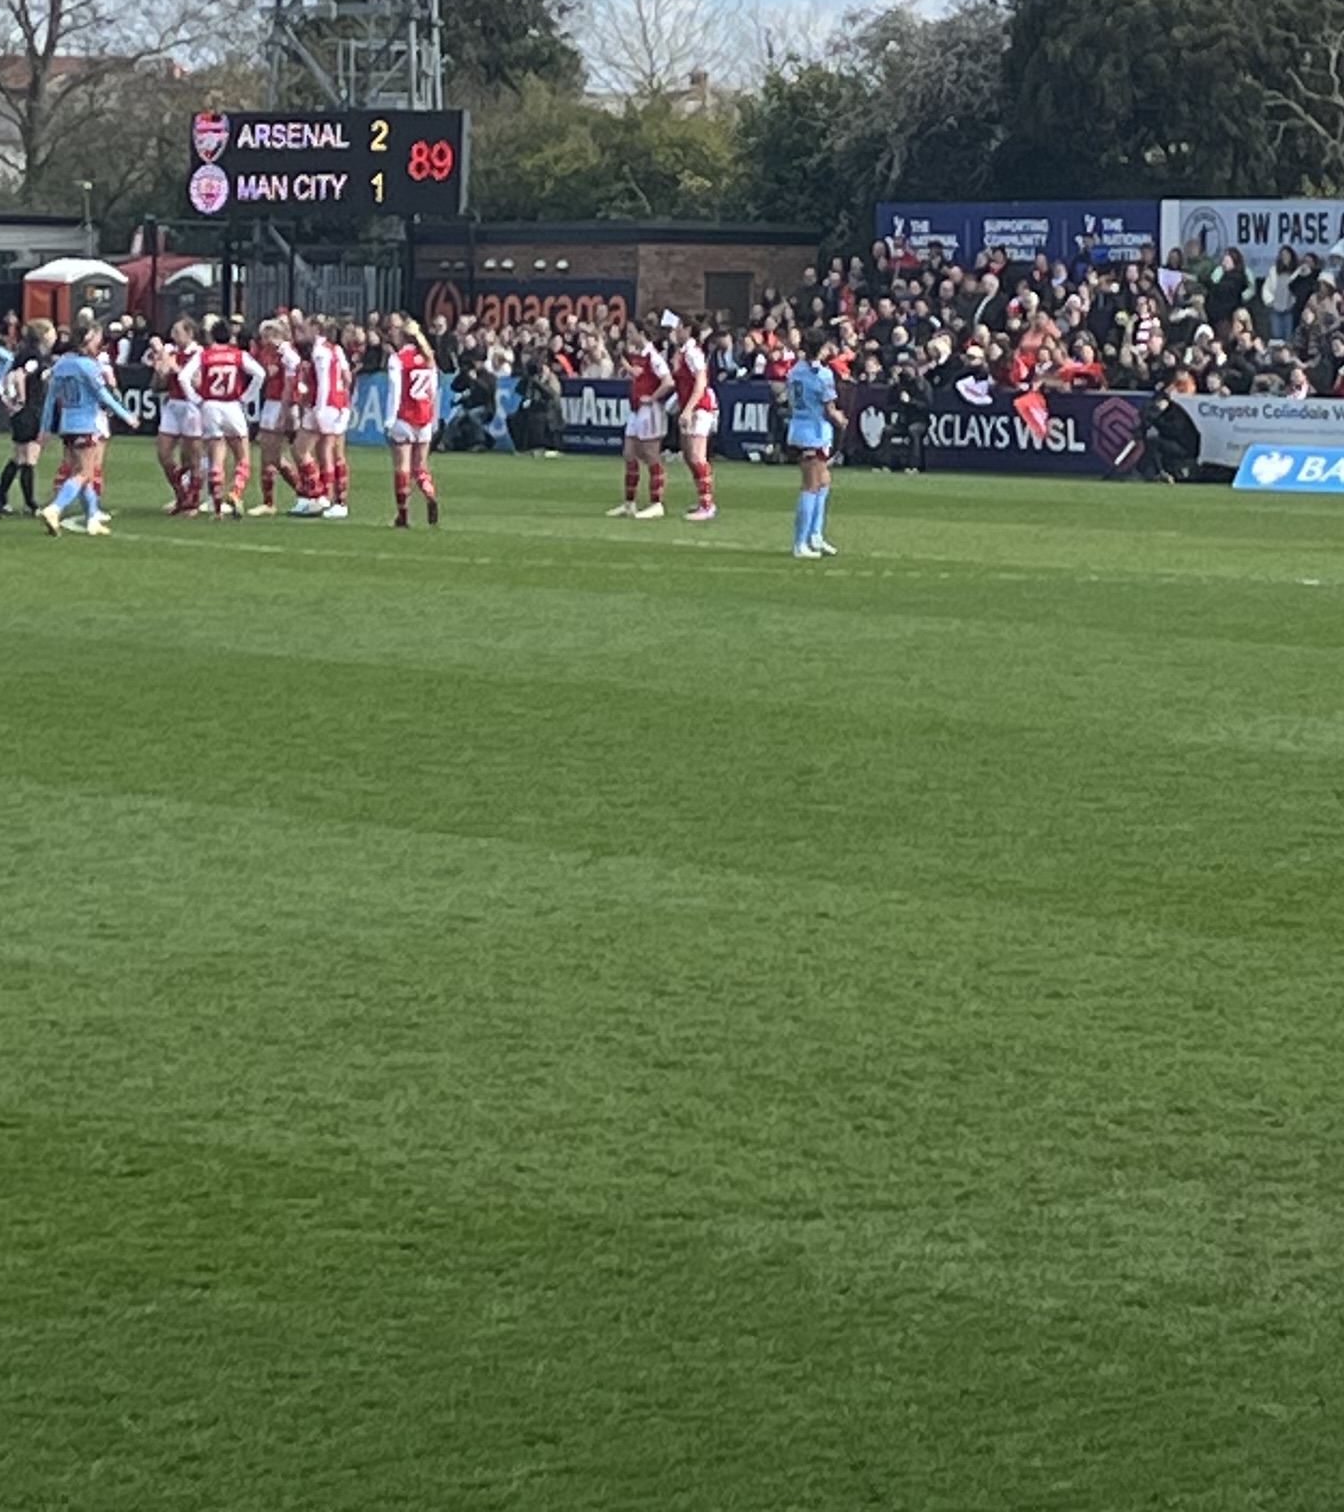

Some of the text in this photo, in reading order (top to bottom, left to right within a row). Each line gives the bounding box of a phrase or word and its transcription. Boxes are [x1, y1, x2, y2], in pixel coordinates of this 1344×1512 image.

[237, 120, 389, 151] ARSENAL 2
[408, 140, 453, 181] 89
[237, 172, 385, 203] MAN CITY 1
[1236, 212, 1272, 244] BW
[1277, 212, 1329, 244] PASE
[207, 364, 238, 397] 27
[1197, 403, 1258, 423] Citygate
[1261, 402, 1331, 420] Colindale
